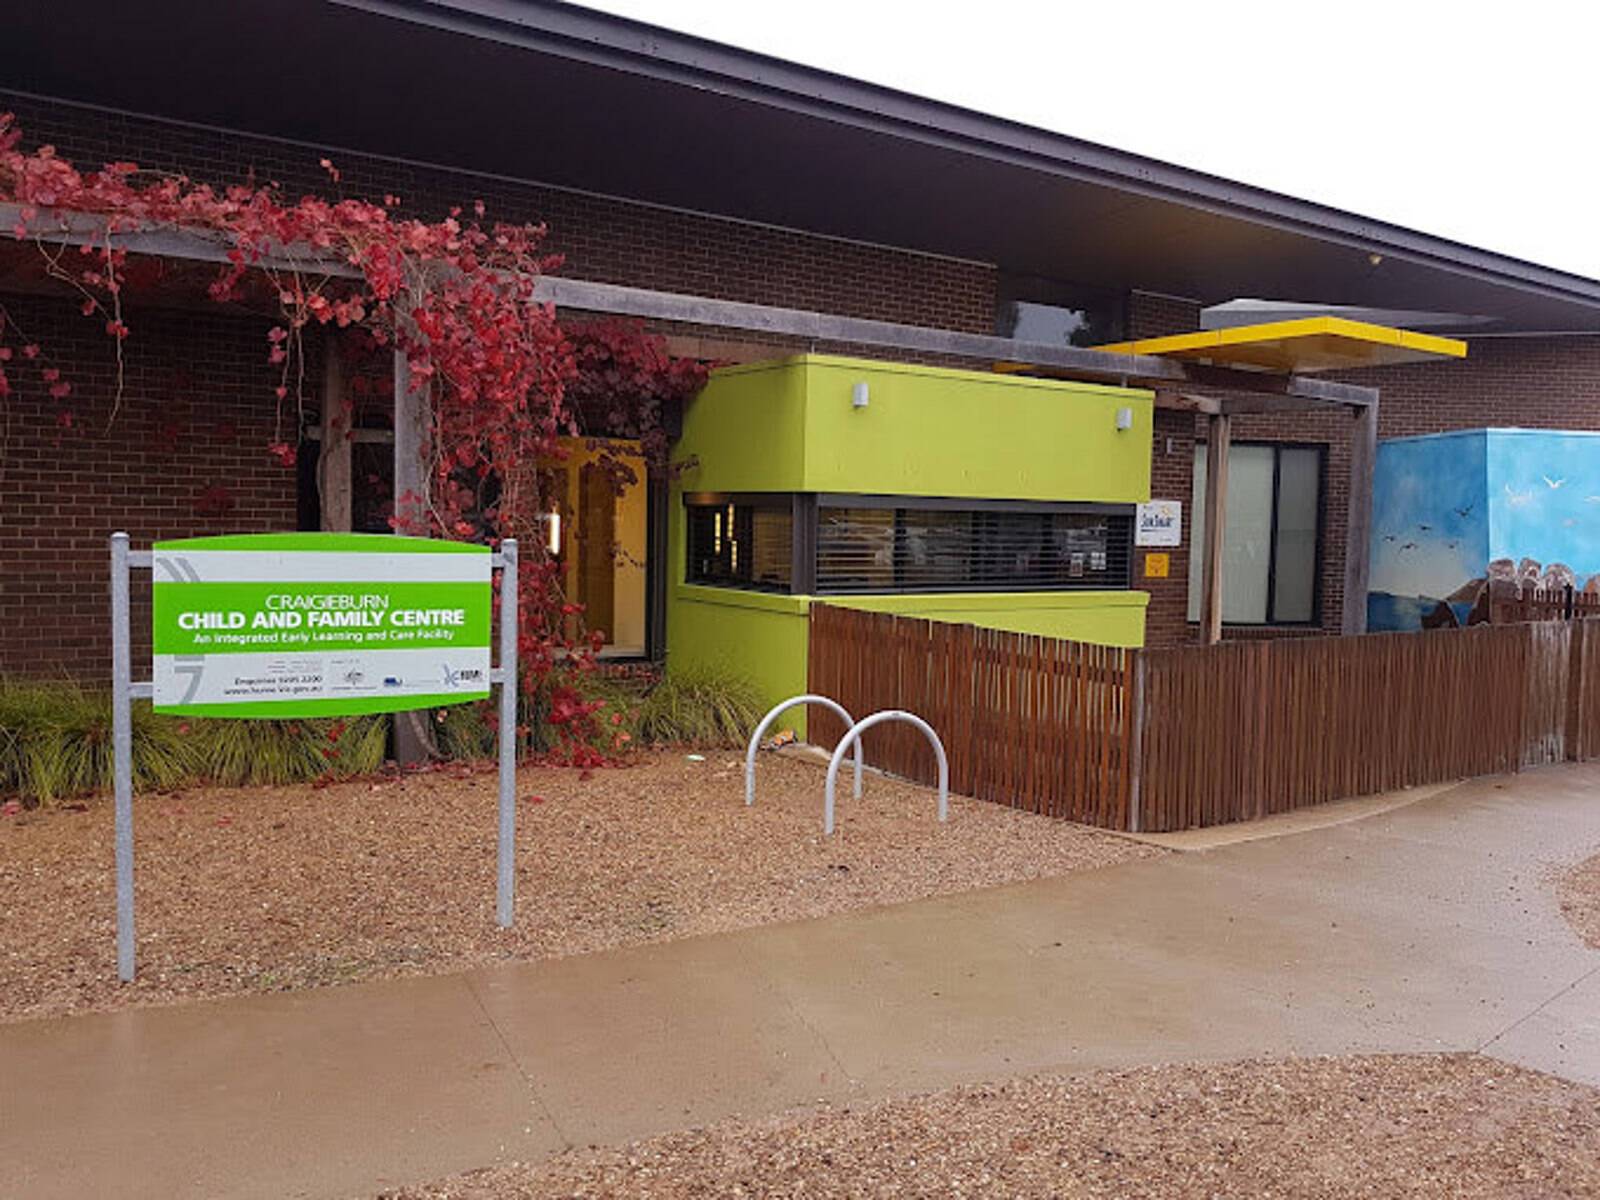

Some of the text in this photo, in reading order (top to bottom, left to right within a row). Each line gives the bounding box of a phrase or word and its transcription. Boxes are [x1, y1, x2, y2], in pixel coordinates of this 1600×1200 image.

[265, 594, 389, 610] CRAIGIEBURN
[178, 608, 465, 629] CHILD AND FAMILY CENTRE
[193, 628, 455, 645] An Integrated Early Learning and Care Facility
